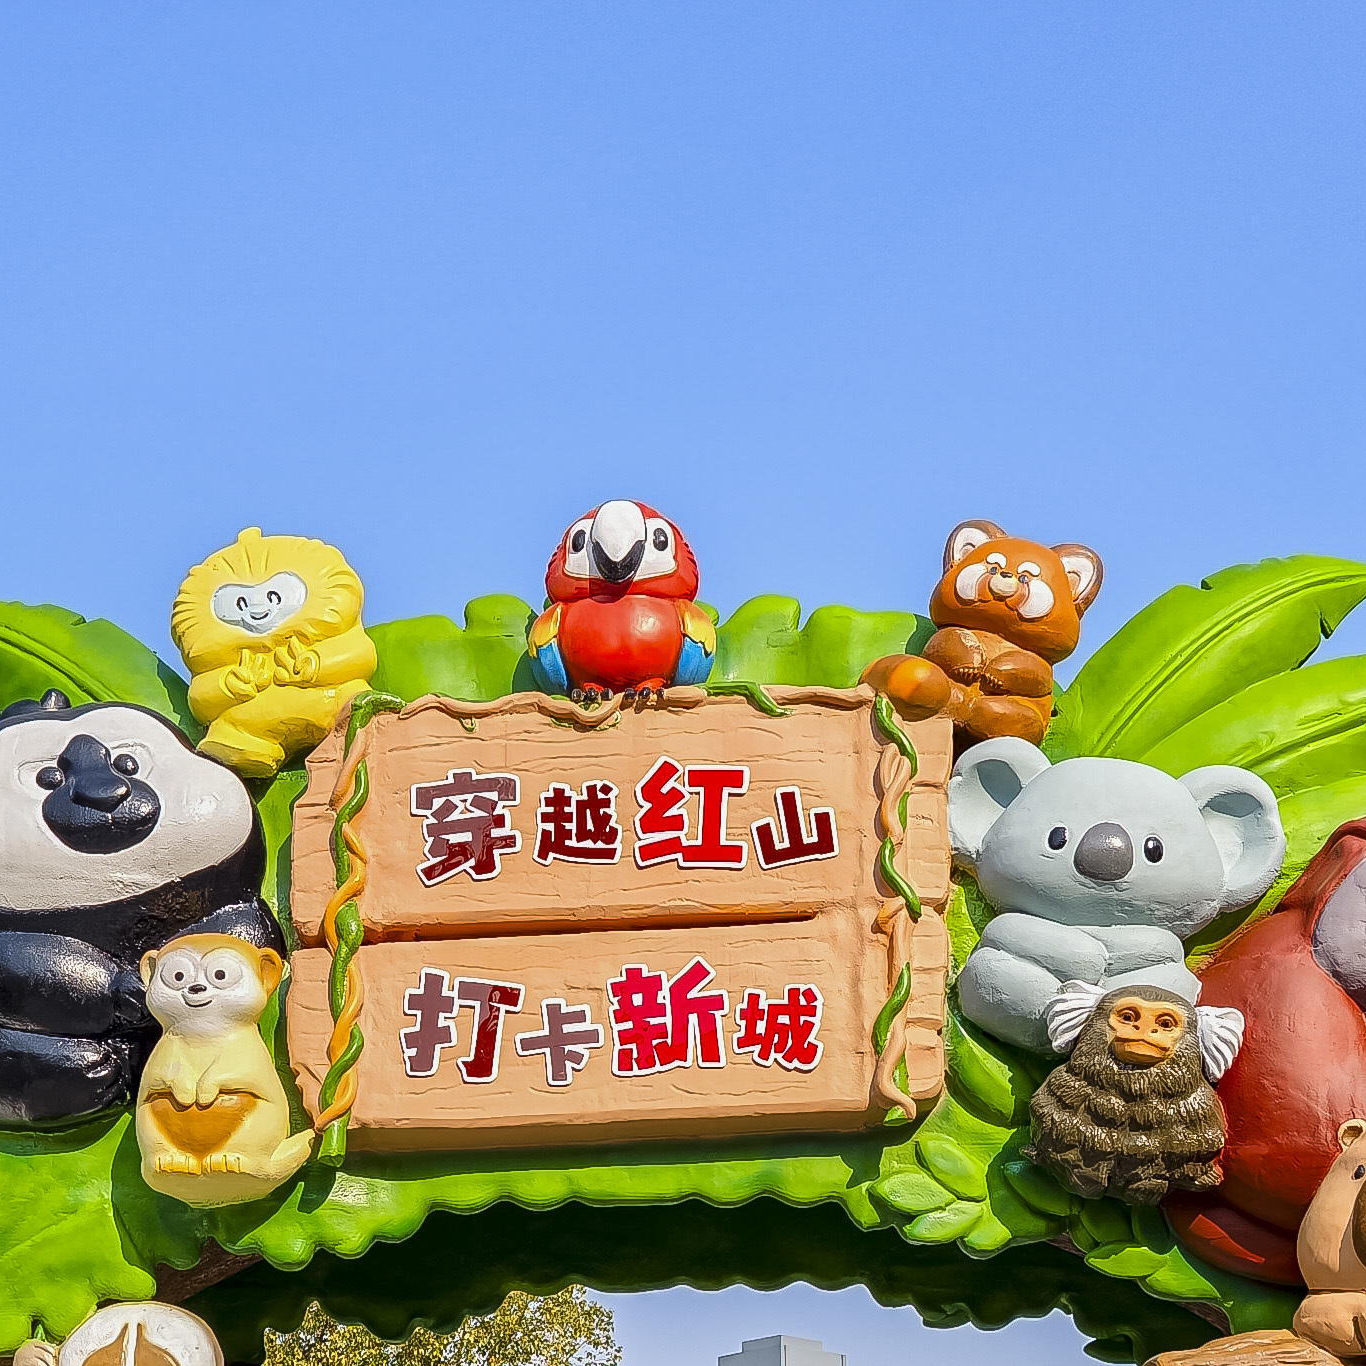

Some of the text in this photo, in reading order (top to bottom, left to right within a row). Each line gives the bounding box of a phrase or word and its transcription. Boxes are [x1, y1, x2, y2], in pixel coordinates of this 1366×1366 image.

[411, 756, 839, 886] 穿越红山
[401, 956, 824, 1086] 打卡新城
